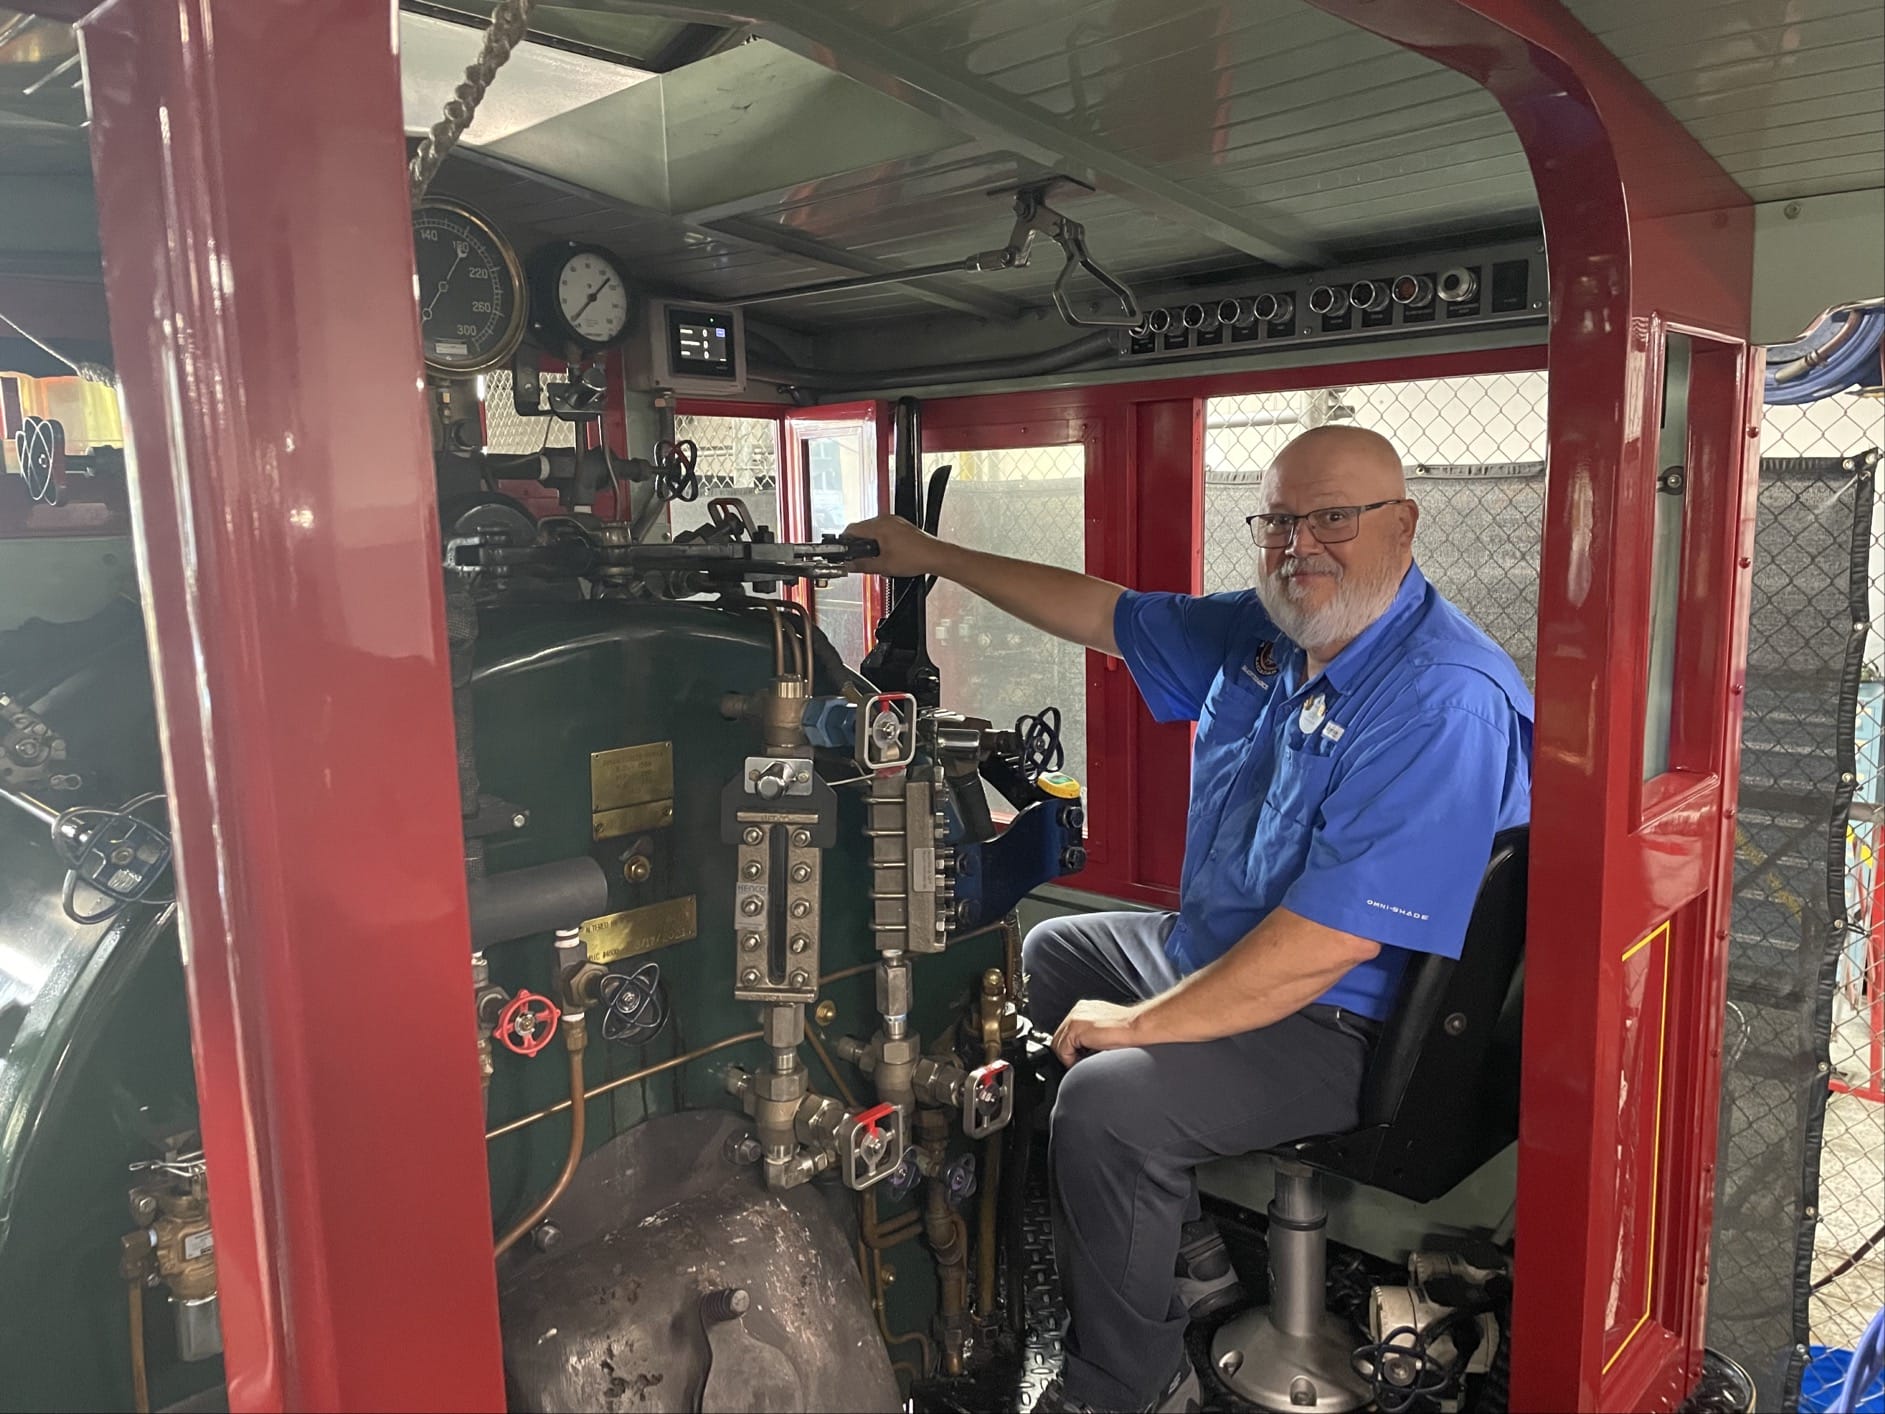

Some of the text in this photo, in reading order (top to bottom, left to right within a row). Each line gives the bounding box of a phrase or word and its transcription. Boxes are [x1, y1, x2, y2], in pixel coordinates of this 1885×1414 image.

[420, 229, 438, 241] 140
[468, 267, 489, 279] 220
[472, 301, 492, 313] 260
[456, 324, 477, 336] 300
[1366, 899, 1430, 921] OMNI-SHADE
